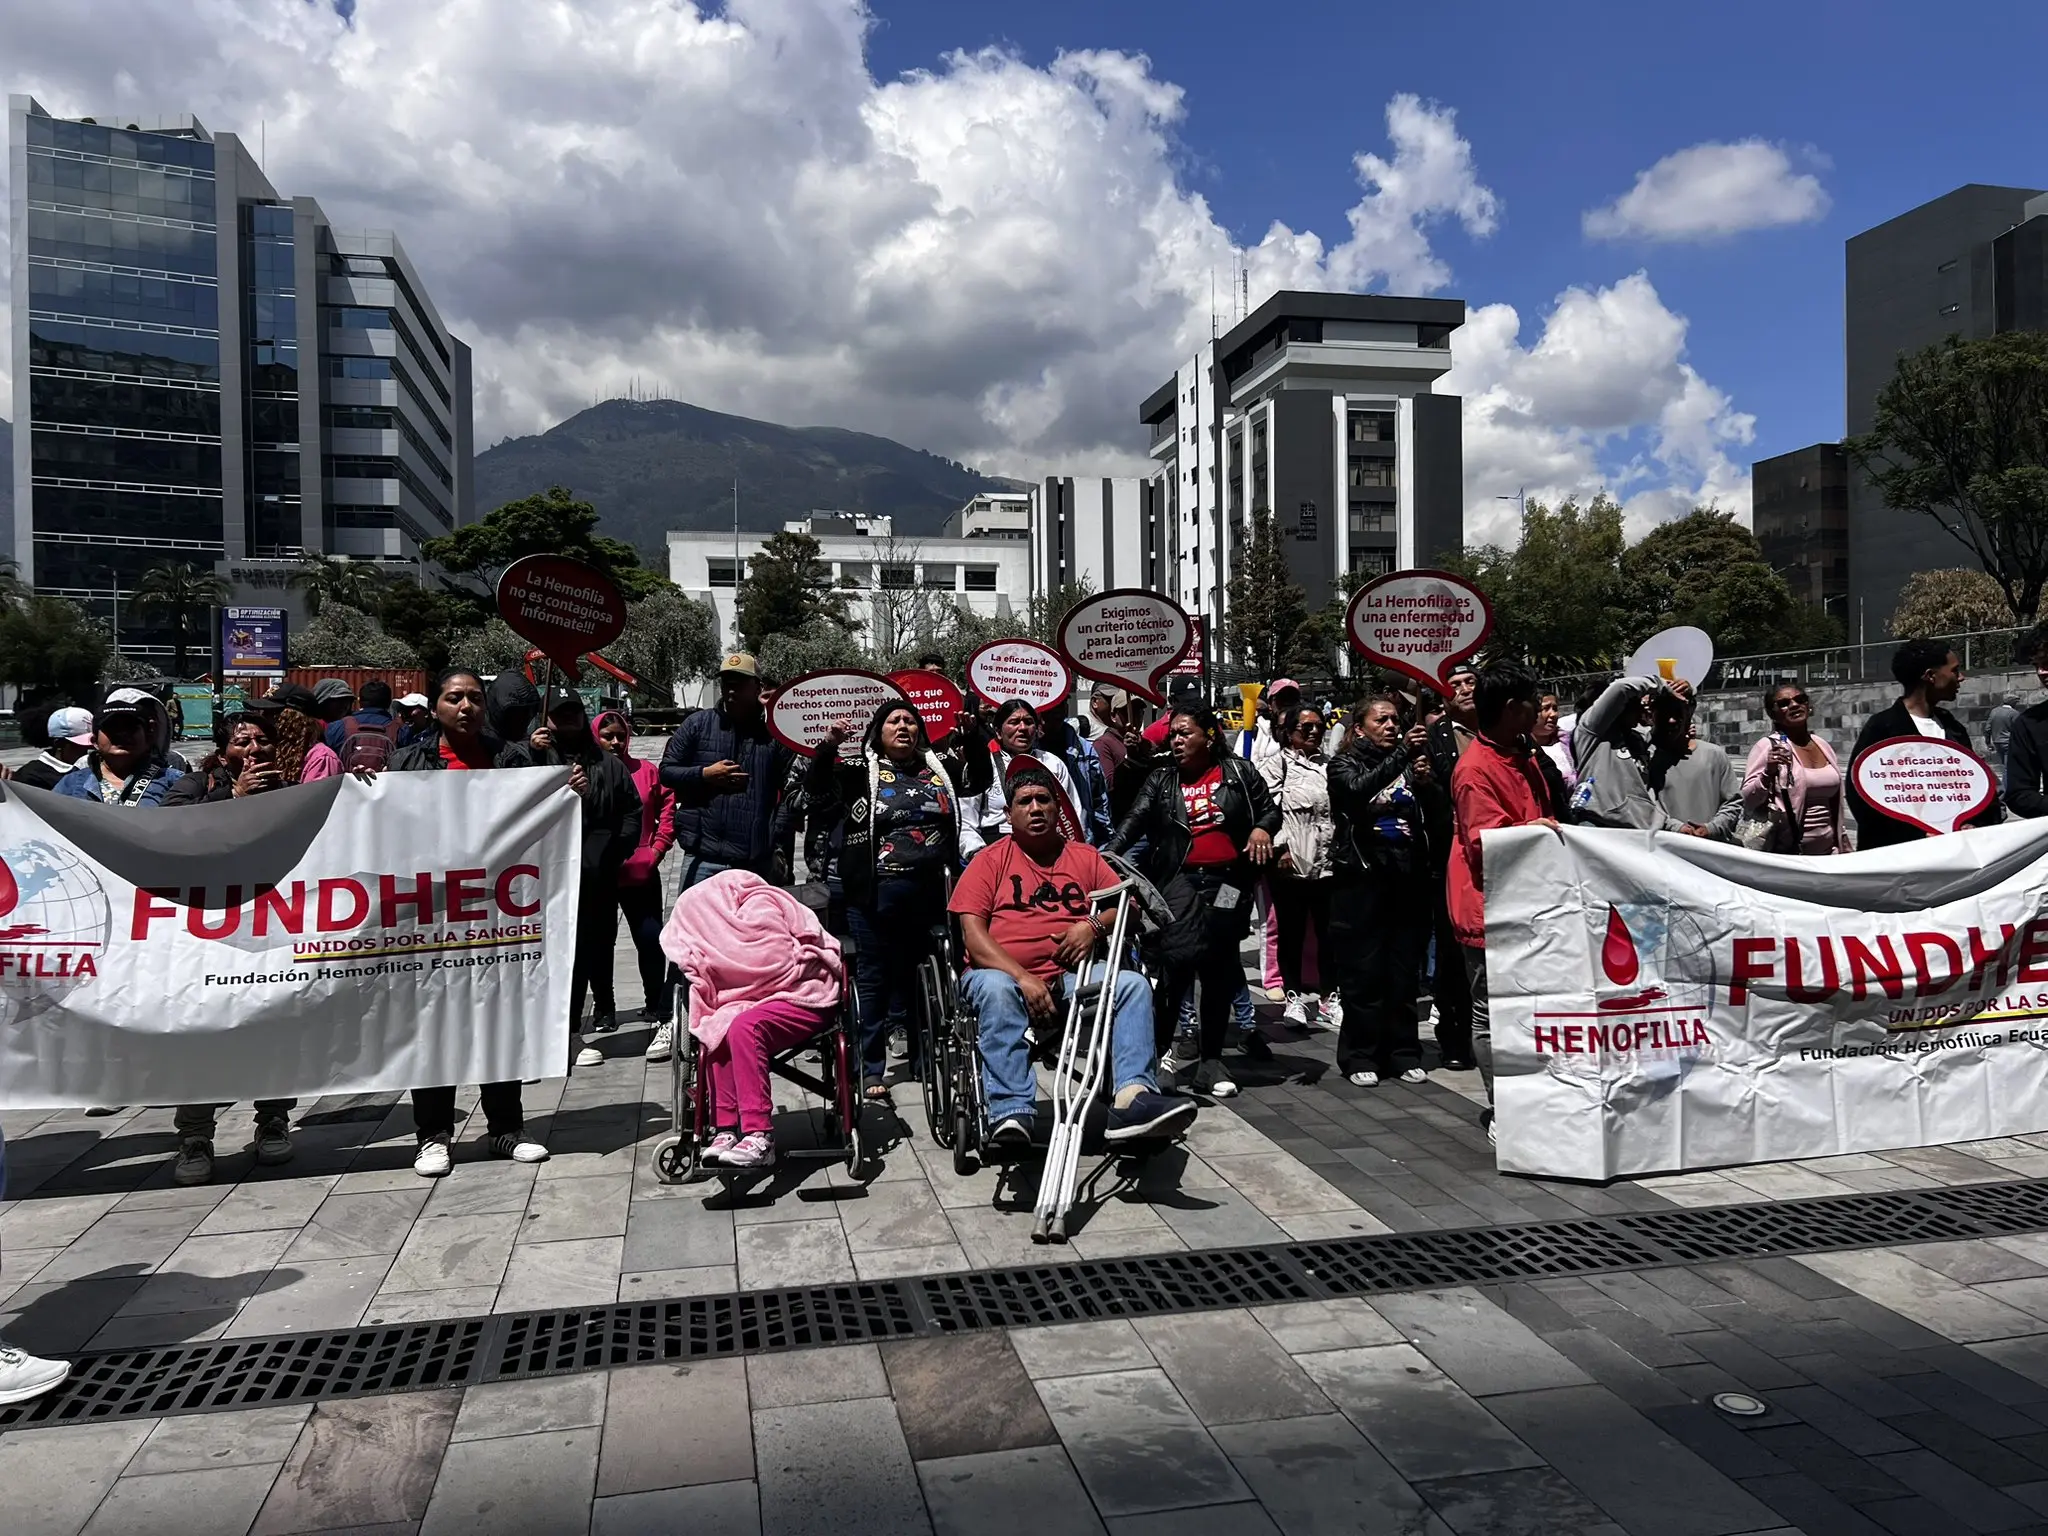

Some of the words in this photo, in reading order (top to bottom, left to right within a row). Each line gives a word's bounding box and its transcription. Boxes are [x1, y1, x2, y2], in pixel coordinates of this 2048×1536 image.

[526, 571, 542, 586] La
[544, 576, 605, 605] Hemofilia
[509, 586, 526, 599] no
[528, 591, 543, 603] es
[545, 596, 613, 624] contagiosa
[1367, 595, 1382, 608] La
[1385, 595, 1453, 608] Hemofilia
[1455, 598, 1470, 608] es
[520, 603, 596, 635] infórmate!!!
[1101, 607, 1151, 620] Exigimos
[1362, 613, 1387, 623] una
[1390, 610, 1475, 623] enfermedad
[1078, 625, 1092, 634] un
[1095, 621, 1134, 633] criterio
[1136, 618, 1174, 630] técnico
[1374, 628, 1400, 641] que
[1403, 626, 1460, 638] necesita
[1087, 637, 1112, 649] para
[1115, 634, 1125, 645] la
[1127, 633, 1167, 647] compra
[1380, 642, 1394, 653] tu
[1397, 640, 1452, 656] ayuda!!!
[990, 653, 1001, 662] La
[1004, 655, 1038, 665] eficacia
[1040, 658, 1051, 667] de
[1079, 650, 1094, 661] de
[1096, 645, 1175, 661] medicamentos
[980, 663, 993, 671] los
[995, 664, 1058, 677] medicamentos
[988, 675, 1018, 684] mejora
[1020, 678, 1053, 687] nuestra
[792, 686, 840, 698] Respeten
[841, 684, 884, 695] nuestros
[908, 690, 921, 698] os
[923, 689, 943, 698] que
[985, 684, 1017, 694] calidad
[1018, 688, 1029, 696] de
[1031, 690, 1050, 698] vida
[777, 699, 822, 710] derechos
[824, 699, 852, 709] como
[802, 711, 820, 721] con
[822, 710, 870, 721] Hemofilia
[1880, 757, 1894, 766] La
[1897, 756, 1943, 766] eficacia
[1946, 756, 1960, 765] de
[1869, 770, 1886, 778] los
[1890, 769, 1974, 779] medicamentos
[1884, 782, 1924, 792] mejora
[1927, 781, 1971, 790] nuestra
[1884, 794, 1927, 803] calidad
[1929, 793, 1944, 802] de
[1946, 793, 1971, 802] vida
[1009, 874, 1087, 914] Lee
[130, 865, 541, 941] FUNDHEC
[292, 937, 377, 955] UNIDOS
[384, 933, 426, 948] POR
[433, 930, 457, 943] LA
[464, 923, 542, 941] SANGRE
[204, 968, 310, 986] Fundación
[317, 959, 424, 980] Hemofílica
[431, 950, 542, 969] Ecuatoriana
[1888, 1003, 1960, 1024] UNIDOS
[1964, 998, 2000, 1015] POR
[2006, 995, 2032, 1010] LA
[1533, 1018, 1711, 1053] HEMOFILIA
[1800, 1041, 1898, 1062] Fundación
[1905, 1032, 2002, 1054] Hemofílica
